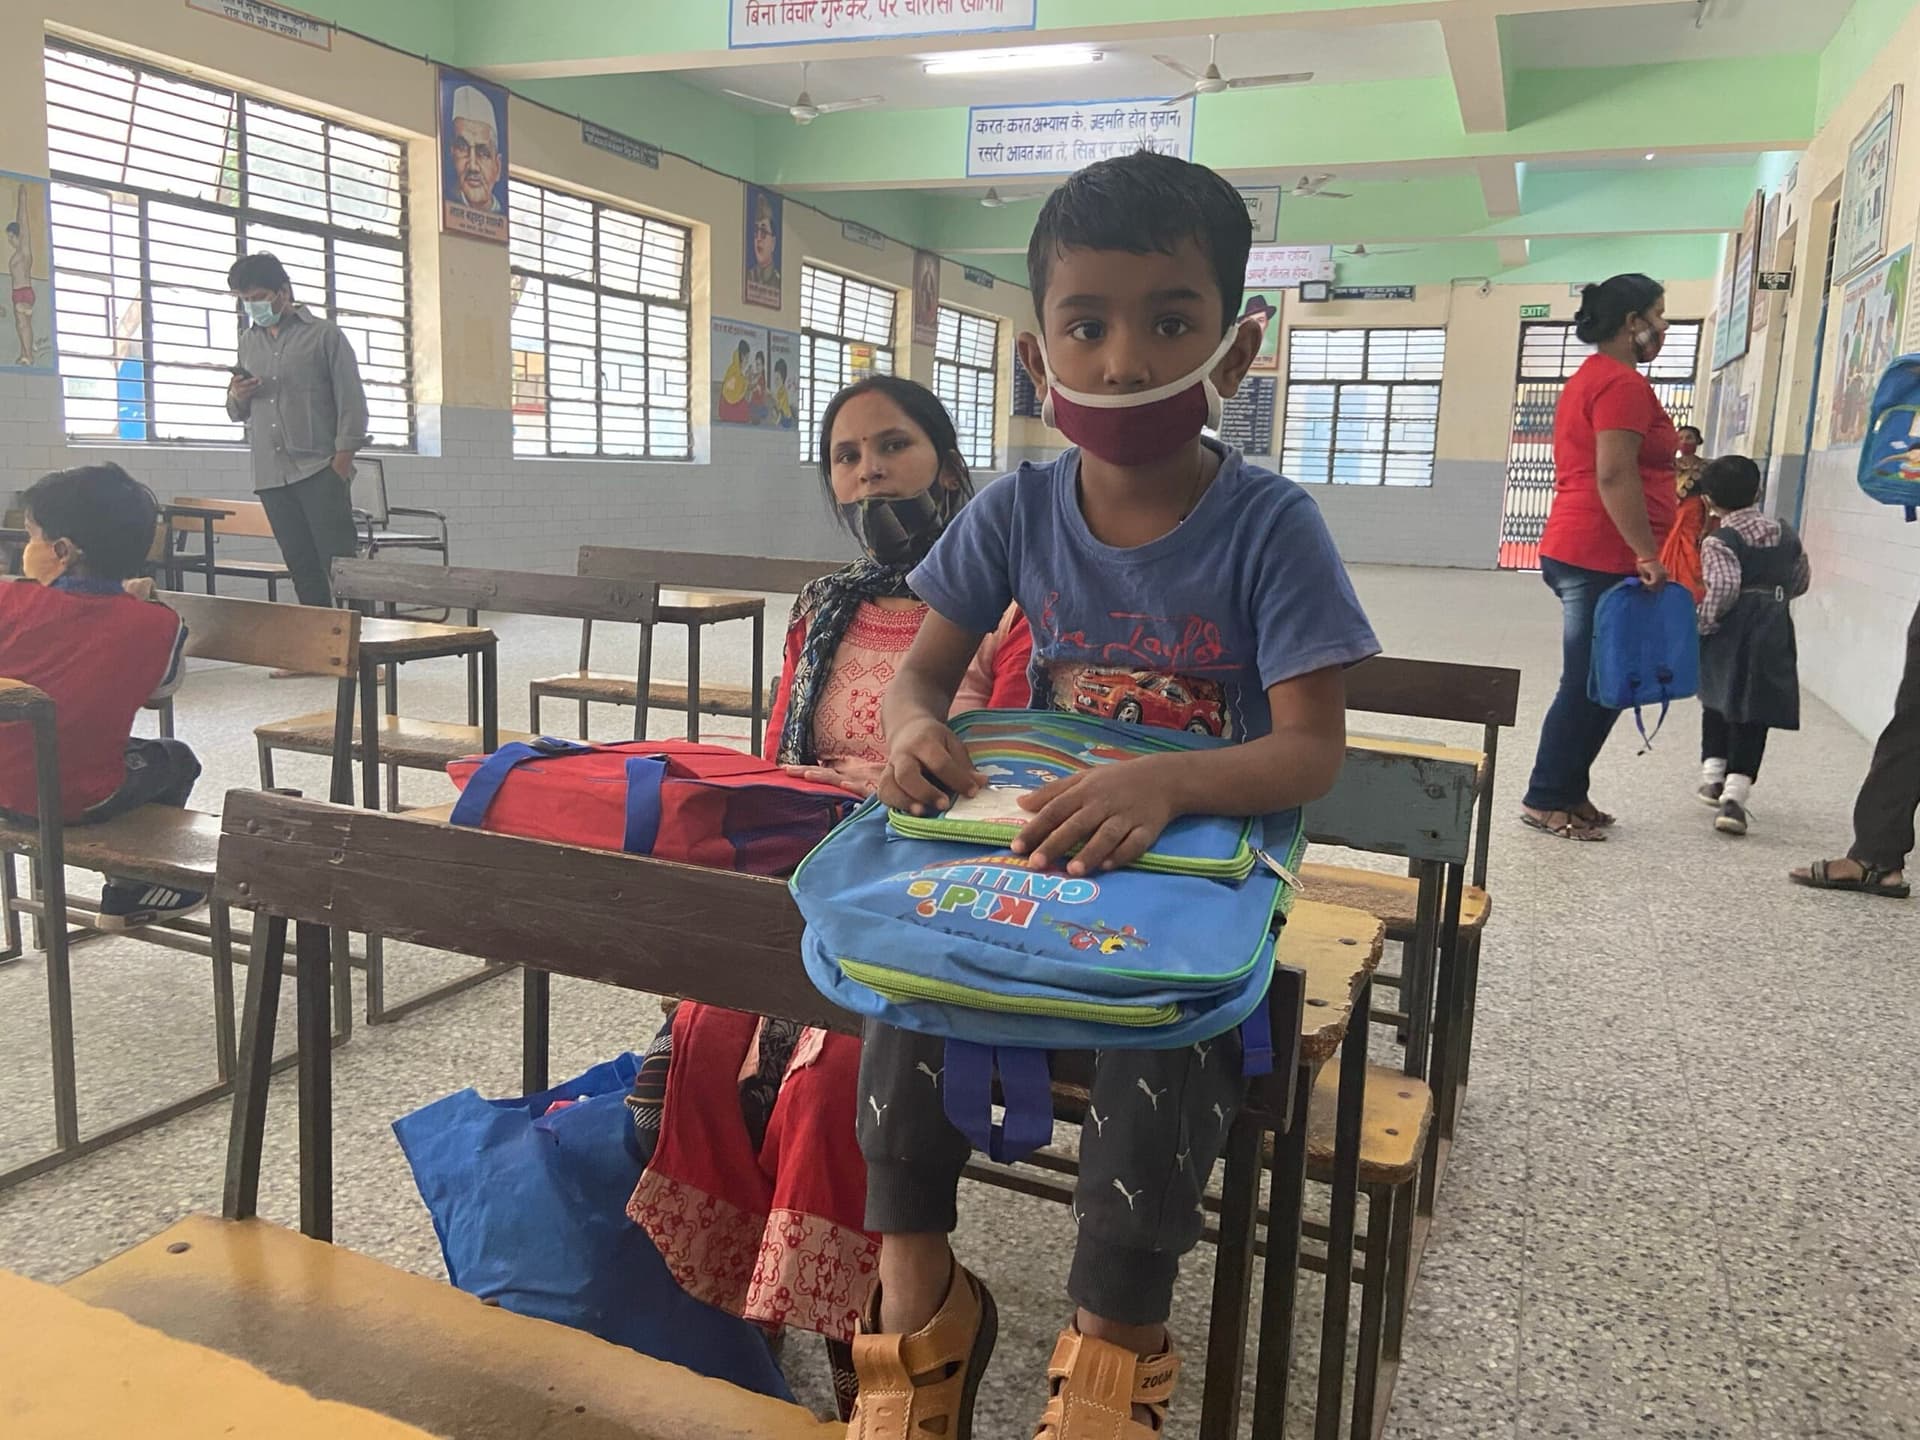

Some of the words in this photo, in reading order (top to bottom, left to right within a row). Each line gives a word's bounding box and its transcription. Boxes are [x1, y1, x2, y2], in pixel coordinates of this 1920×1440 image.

[746, 0, 776, 26] बिना
[978, 143, 1005, 163] रसरी
[1007, 144, 1034, 162] आवत
[1520, 306, 1543, 317] EXIT
